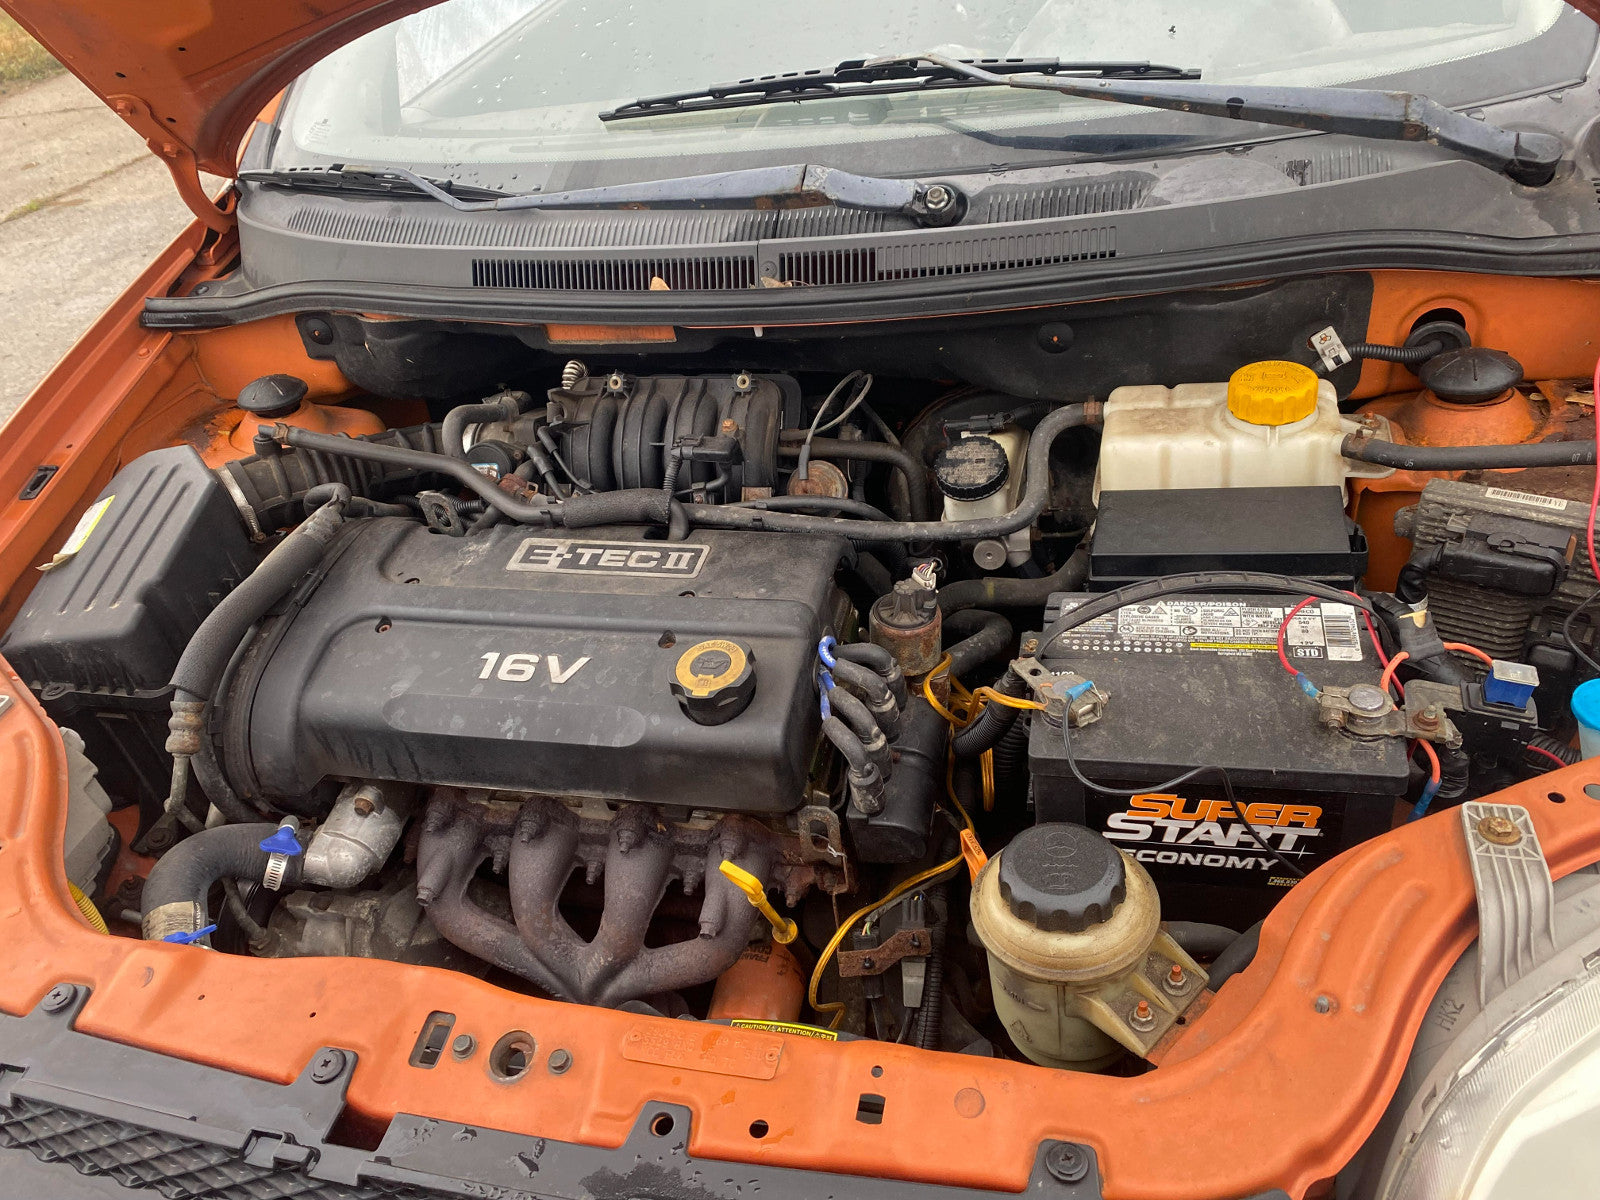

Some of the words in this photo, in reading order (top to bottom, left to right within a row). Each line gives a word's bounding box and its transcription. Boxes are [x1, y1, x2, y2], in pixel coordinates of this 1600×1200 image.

[1166, 600, 1247, 608] DANGER/POISON
[478, 652, 592, 684] 16V
[1296, 648, 1319, 657] STD
[1126, 793, 1323, 828] SUPER
[1102, 812, 1322, 850] START
